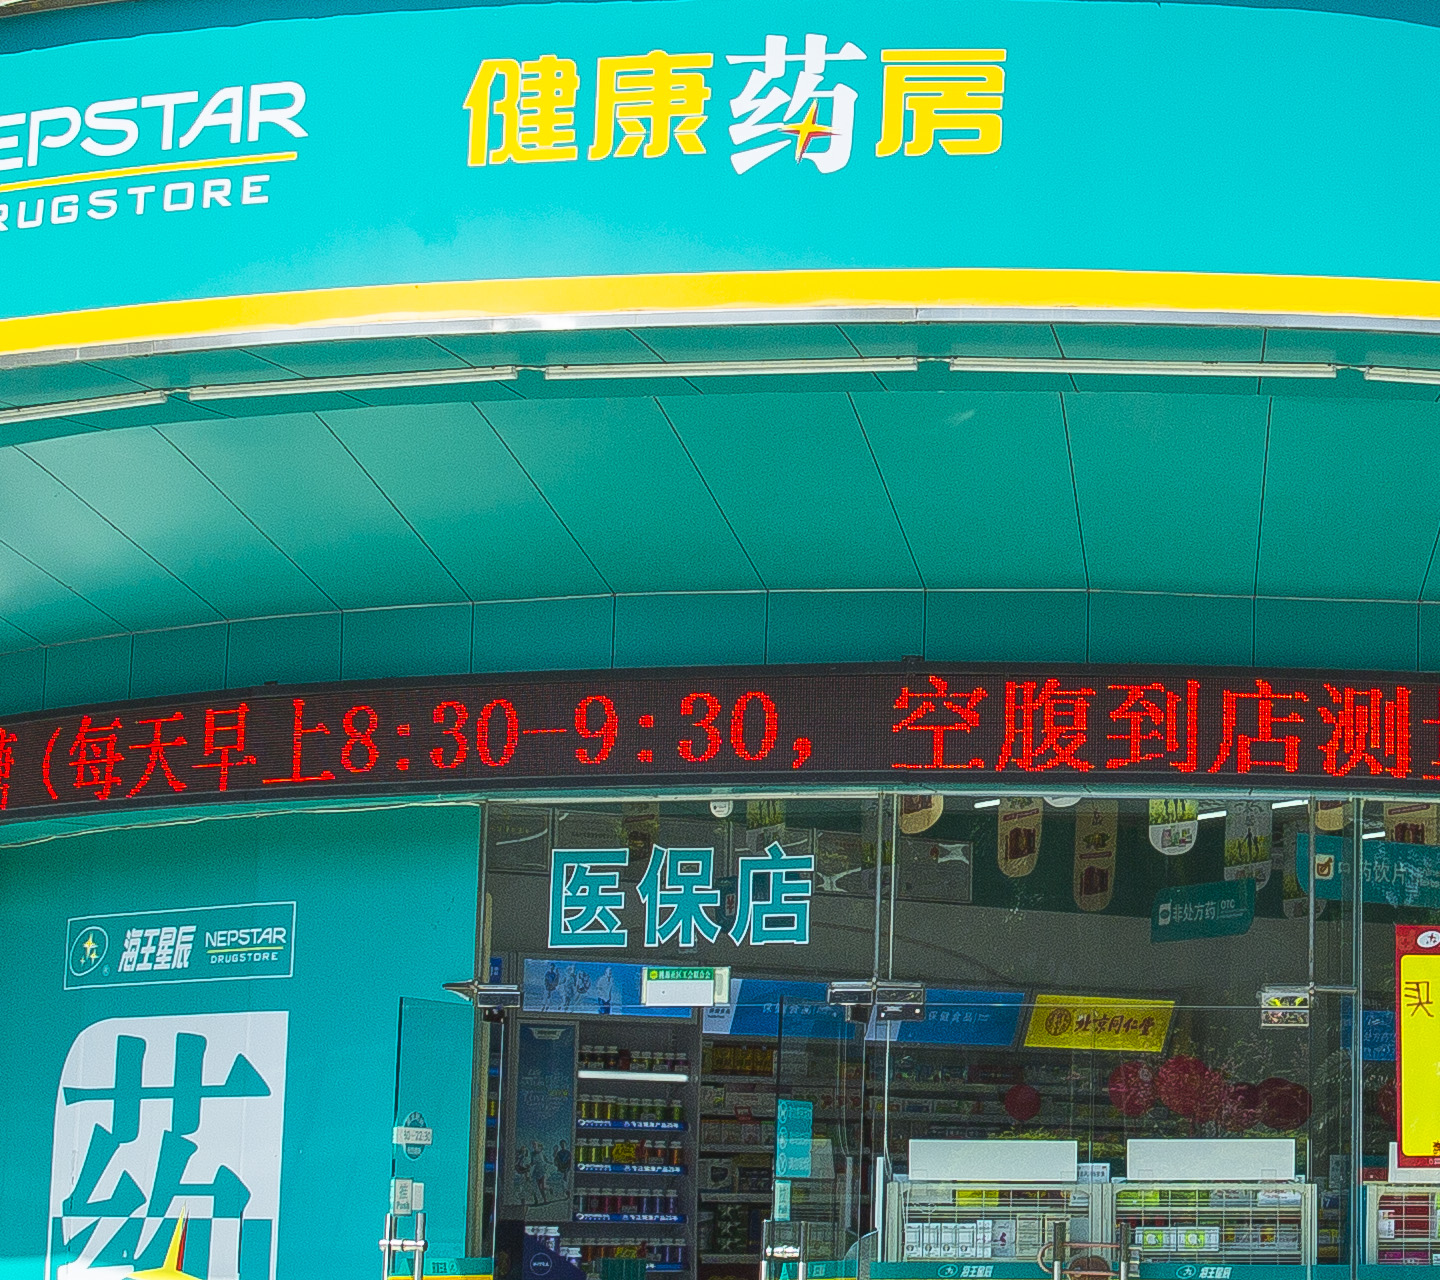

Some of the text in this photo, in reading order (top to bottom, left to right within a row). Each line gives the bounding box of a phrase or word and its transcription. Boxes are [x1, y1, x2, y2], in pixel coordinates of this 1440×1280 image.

[463, 33, 1008, 175] 健康药房
[547, 841, 816, 949] 医保店
[1172, 899, 1235, 922] 非处方药 OTC
[204, 925, 286, 948] NEPSTAR
[118, 925, 197, 972] 海王星辰
[210, 951, 278, 963] DRUGSTORE
[1074, 1014, 1156, 1036] 北京同仁堂
